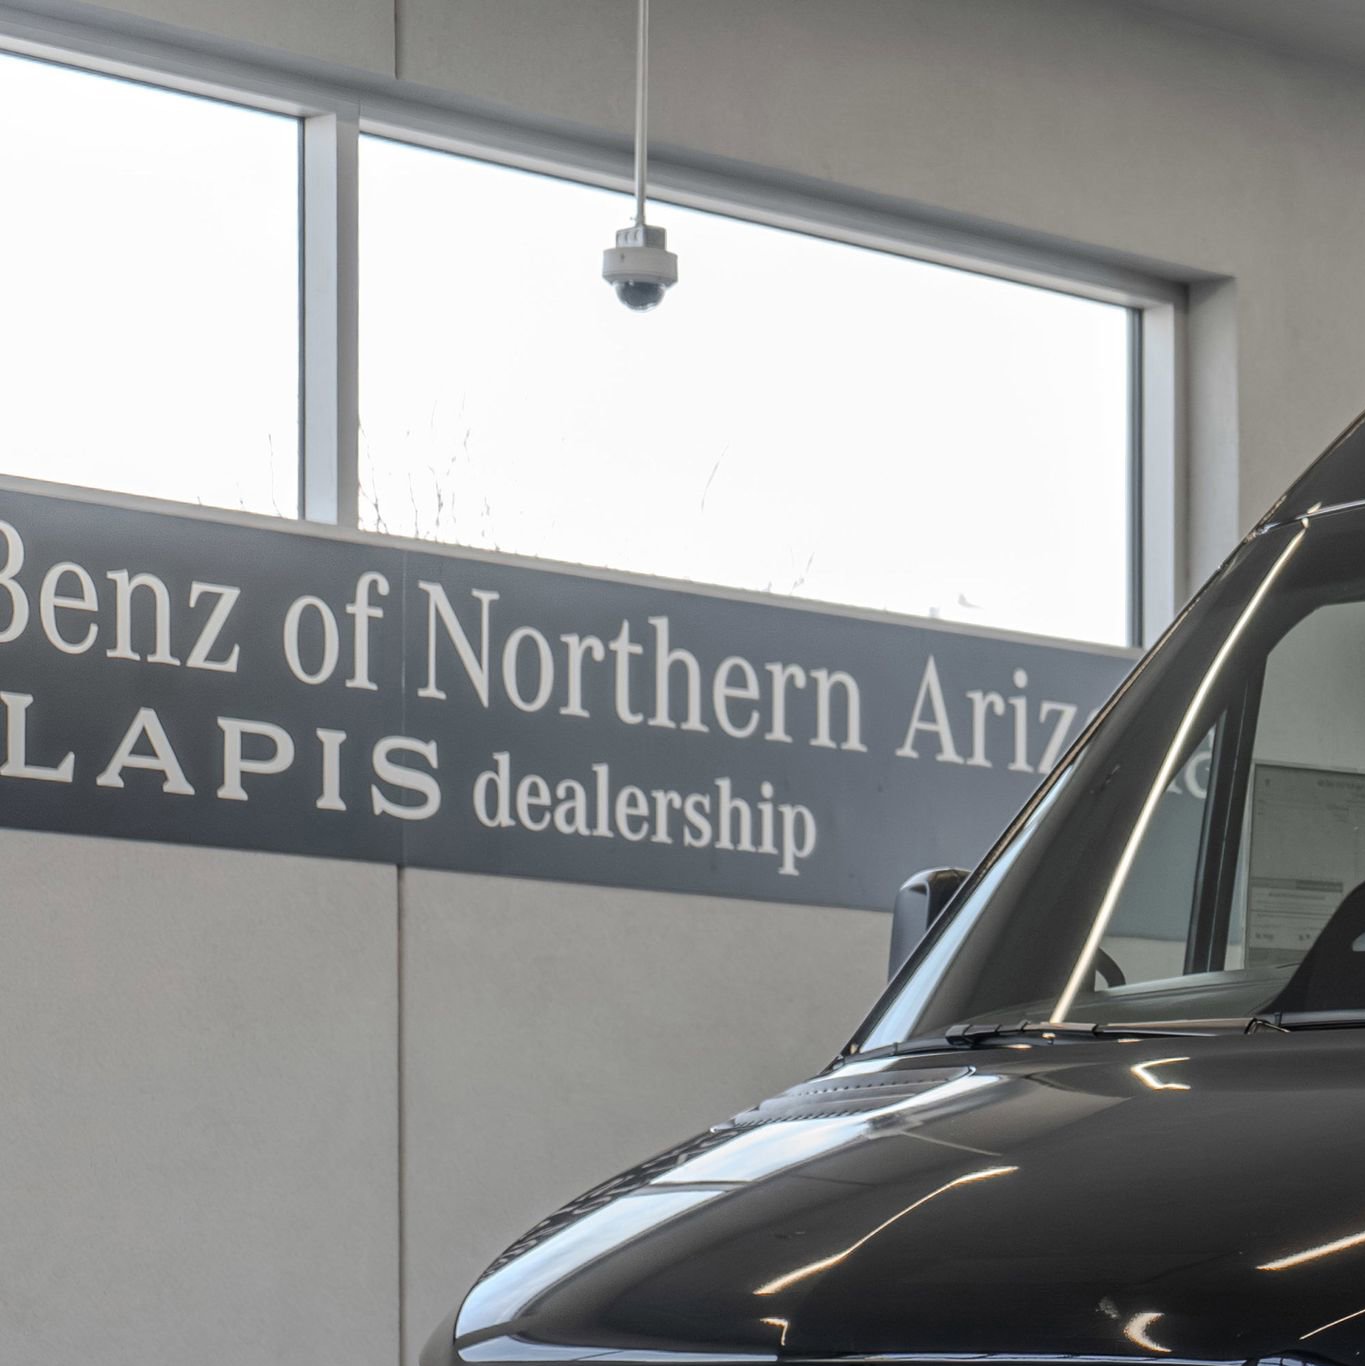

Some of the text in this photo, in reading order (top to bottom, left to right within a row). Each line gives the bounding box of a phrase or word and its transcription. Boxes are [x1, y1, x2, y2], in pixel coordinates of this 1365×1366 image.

[284, 572, 390, 690] of
[418, 581, 867, 752] Northern
[0, 692, 817, 875] LAPIS dealership
